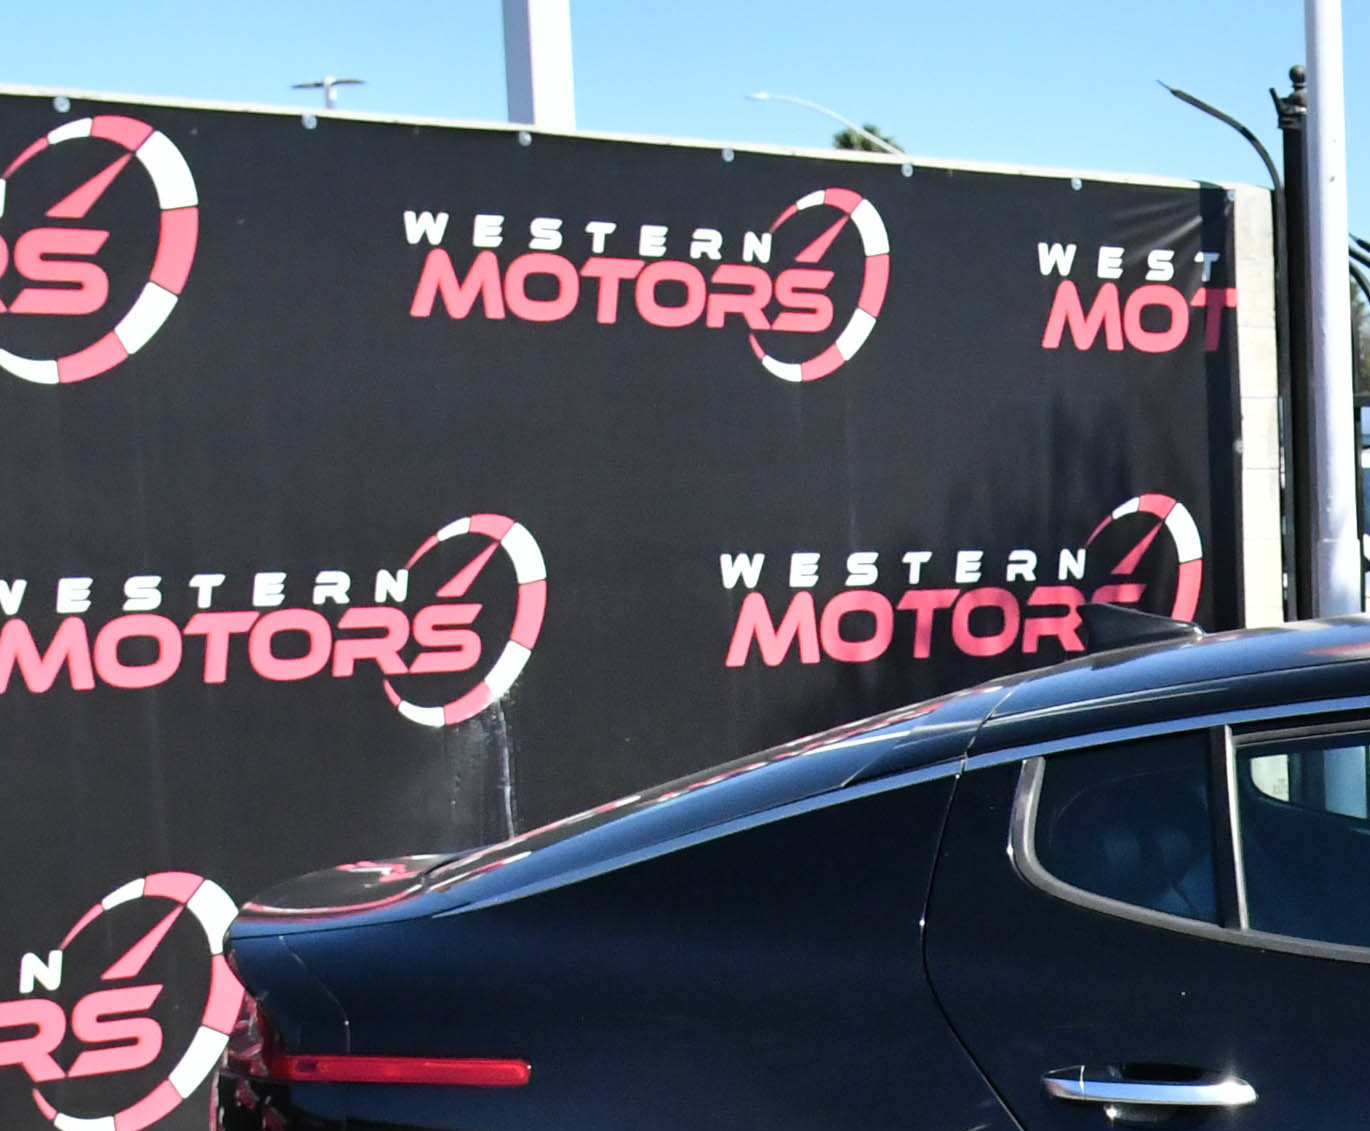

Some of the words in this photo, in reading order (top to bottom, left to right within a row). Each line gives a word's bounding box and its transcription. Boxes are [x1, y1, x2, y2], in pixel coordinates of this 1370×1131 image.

[403, 210, 772, 264] WESTERN
[1037, 242, 1221, 282] WEST
[410, 247, 835, 334] MOTORS
[1041, 279, 1239, 354] MOT
[719, 547, 1087, 590] WESTERN
[0, 603, 483, 695] MOTORS
